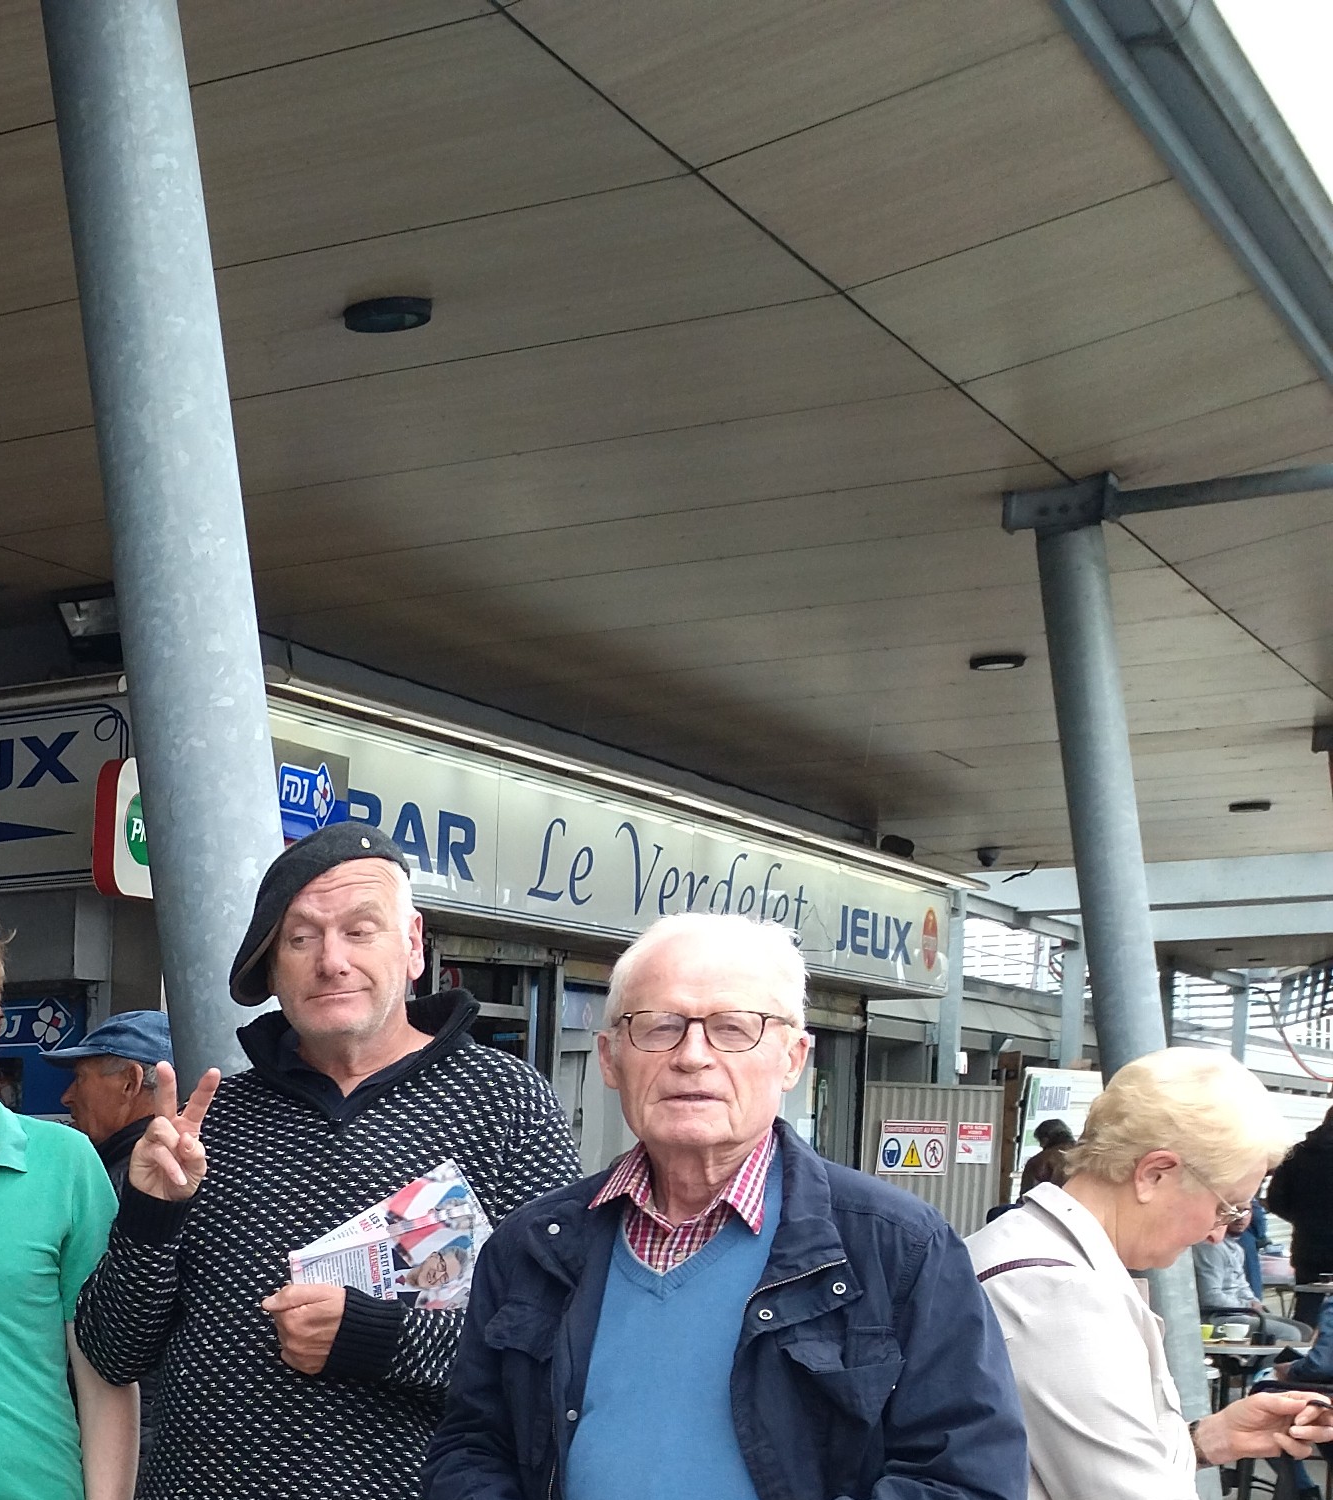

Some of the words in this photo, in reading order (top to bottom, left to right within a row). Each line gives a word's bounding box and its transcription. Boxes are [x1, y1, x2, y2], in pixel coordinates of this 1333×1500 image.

[281, 773, 310, 805] FDJ
[527, 818, 594, 906] Le
[836, 904, 913, 966] JEUX
